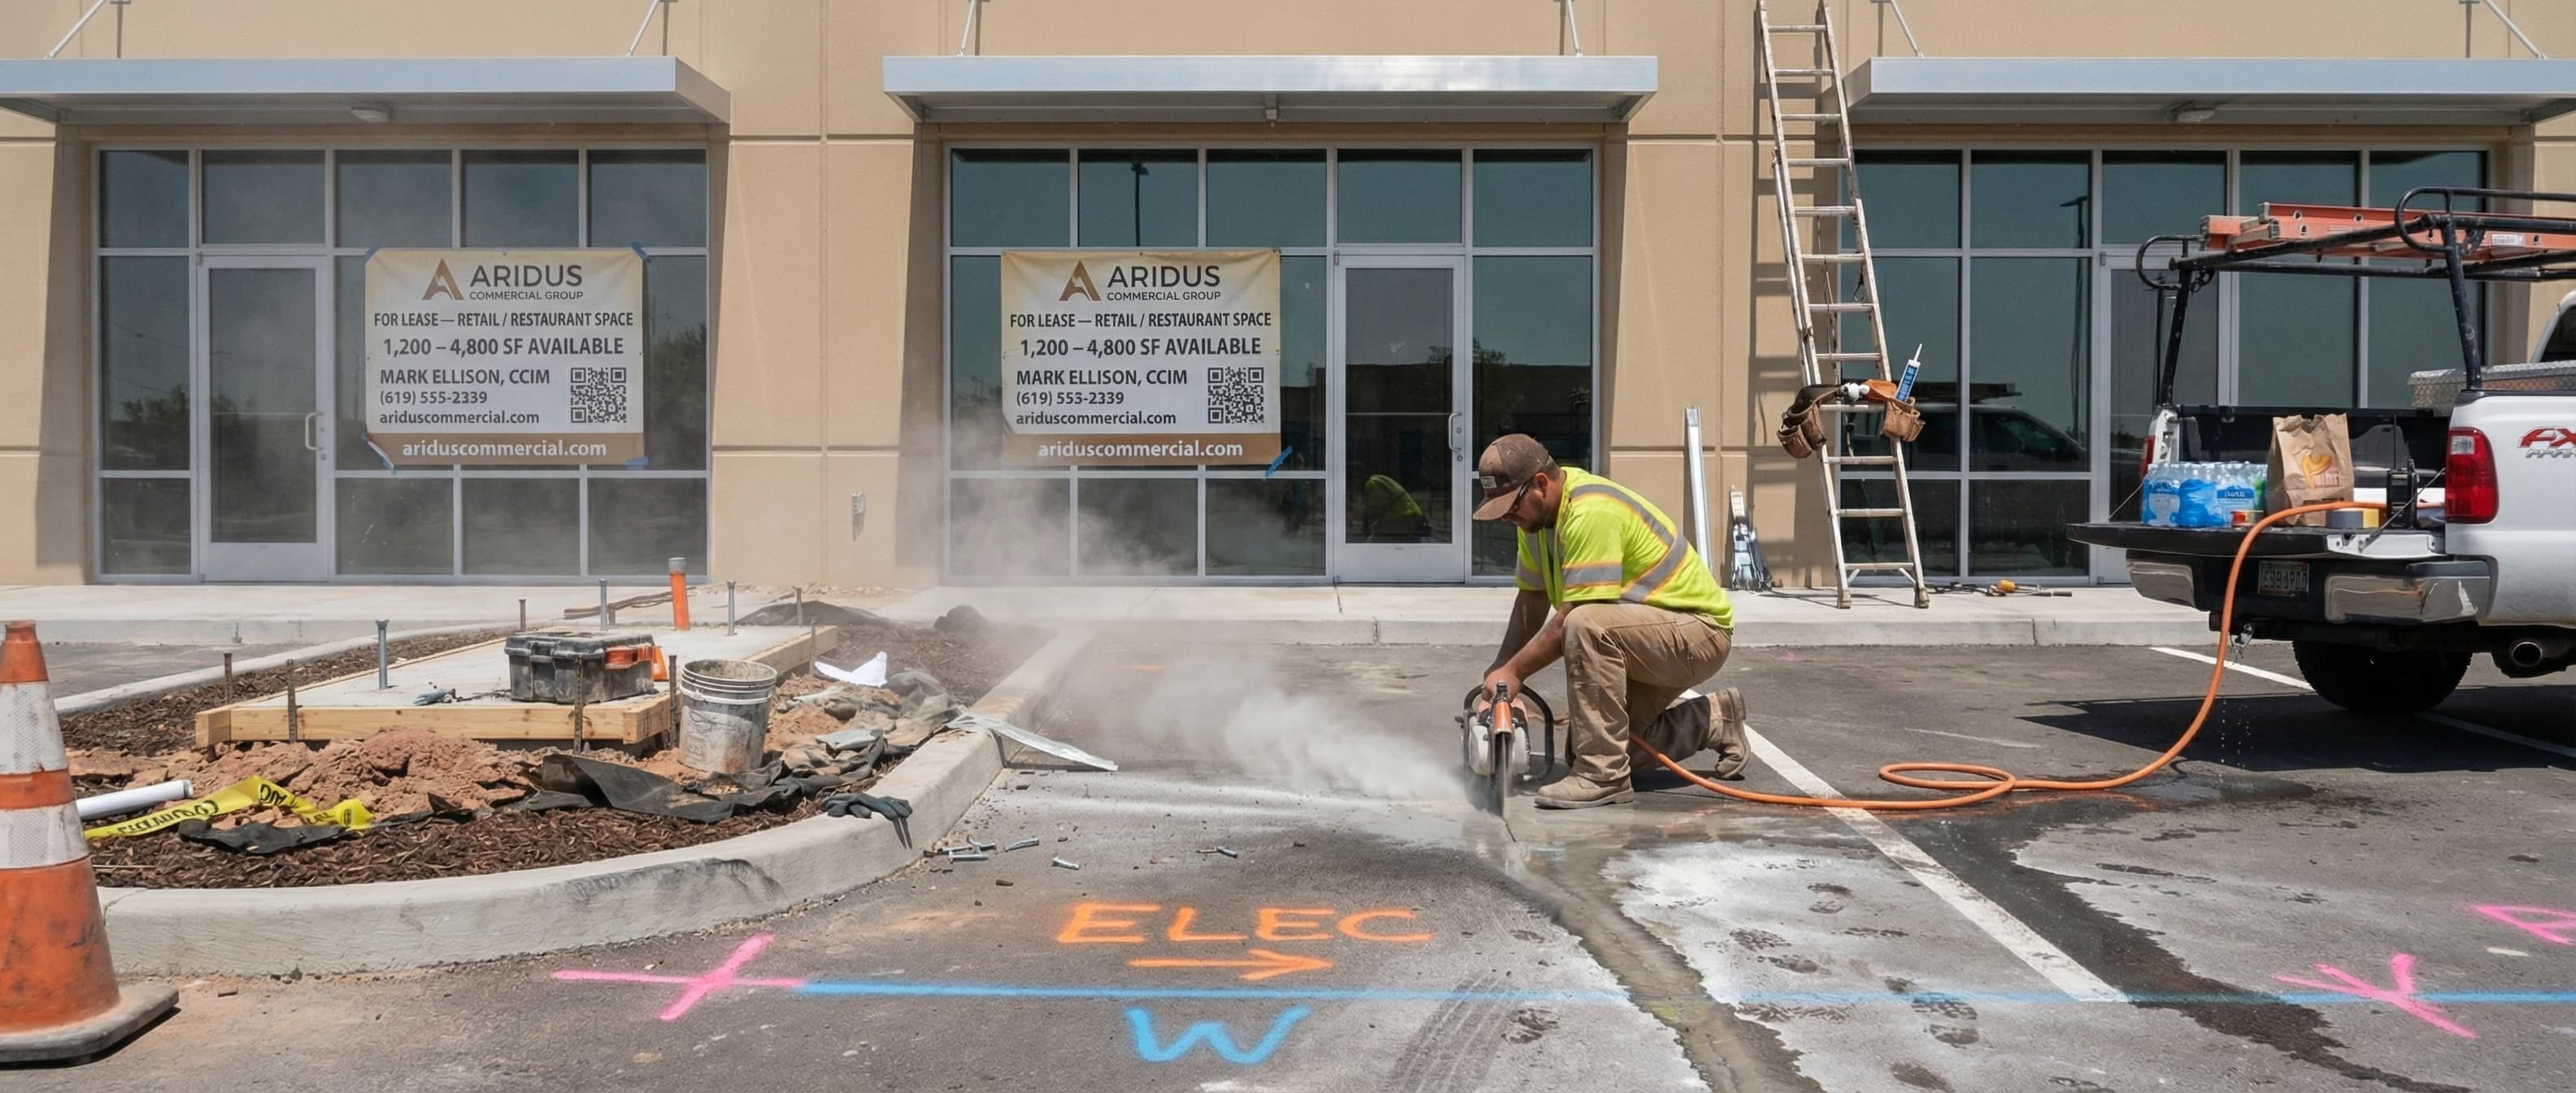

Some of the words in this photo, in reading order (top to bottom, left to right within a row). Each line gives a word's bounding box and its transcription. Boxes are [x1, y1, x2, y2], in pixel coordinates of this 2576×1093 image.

[470, 264, 582, 287] ARIDUS
[1107, 265, 1220, 288] ARIDUS
[470, 291, 542, 299] COMMERCIAL
[545, 291, 583, 299] GROUP
[1107, 292, 1180, 300] COMMERCIAL
[1183, 291, 1221, 300] GROUP
[374, 313, 398, 326] FOR
[458, 313, 499, 326] RETAIL
[511, 312, 592, 326] RESTAURANT
[595, 312, 633, 325] SPACE
[1011, 314, 1034, 327] FOR
[1095, 313, 1137, 327] RETAIL
[1149, 313, 1229, 327] RESTAURANT
[1234, 312, 1271, 326] SPACE
[384, 338, 431, 357] 1,200
[450, 338, 498, 358] 4,800
[503, 338, 523, 355] SF
[528, 337, 624, 355] AVAILABLE
[1021, 340, 1068, 358] 1,200
[1087, 339, 1135, 358] 4,800
[1141, 338, 1160, 355] SF
[1165, 337, 1261, 355] AVAILABLE
[381, 369, 429, 384] MARK
[433, 369, 504, 385] ELLISON,
[509, 369, 550, 384] CCIM
[1017, 370, 1064, 385] MARK
[1069, 370, 1142, 386] ELLISON,
[1147, 370, 1186, 384] CCIM
[381, 390, 416, 405] (619)
[420, 391, 487, 403] 555-2339
[1017, 391, 1052, 406] (619)
[380, 410, 539, 423] ariduscommercial.com
[1016, 411, 1176, 425] ariduscommercial.com
[403, 439, 607, 455] ariduscommercial.com
[1037, 440, 1242, 458] ariduscommercial.com
[1057, 900, 1434, 944] ELEC
[1125, 1006, 1312, 1065] W
